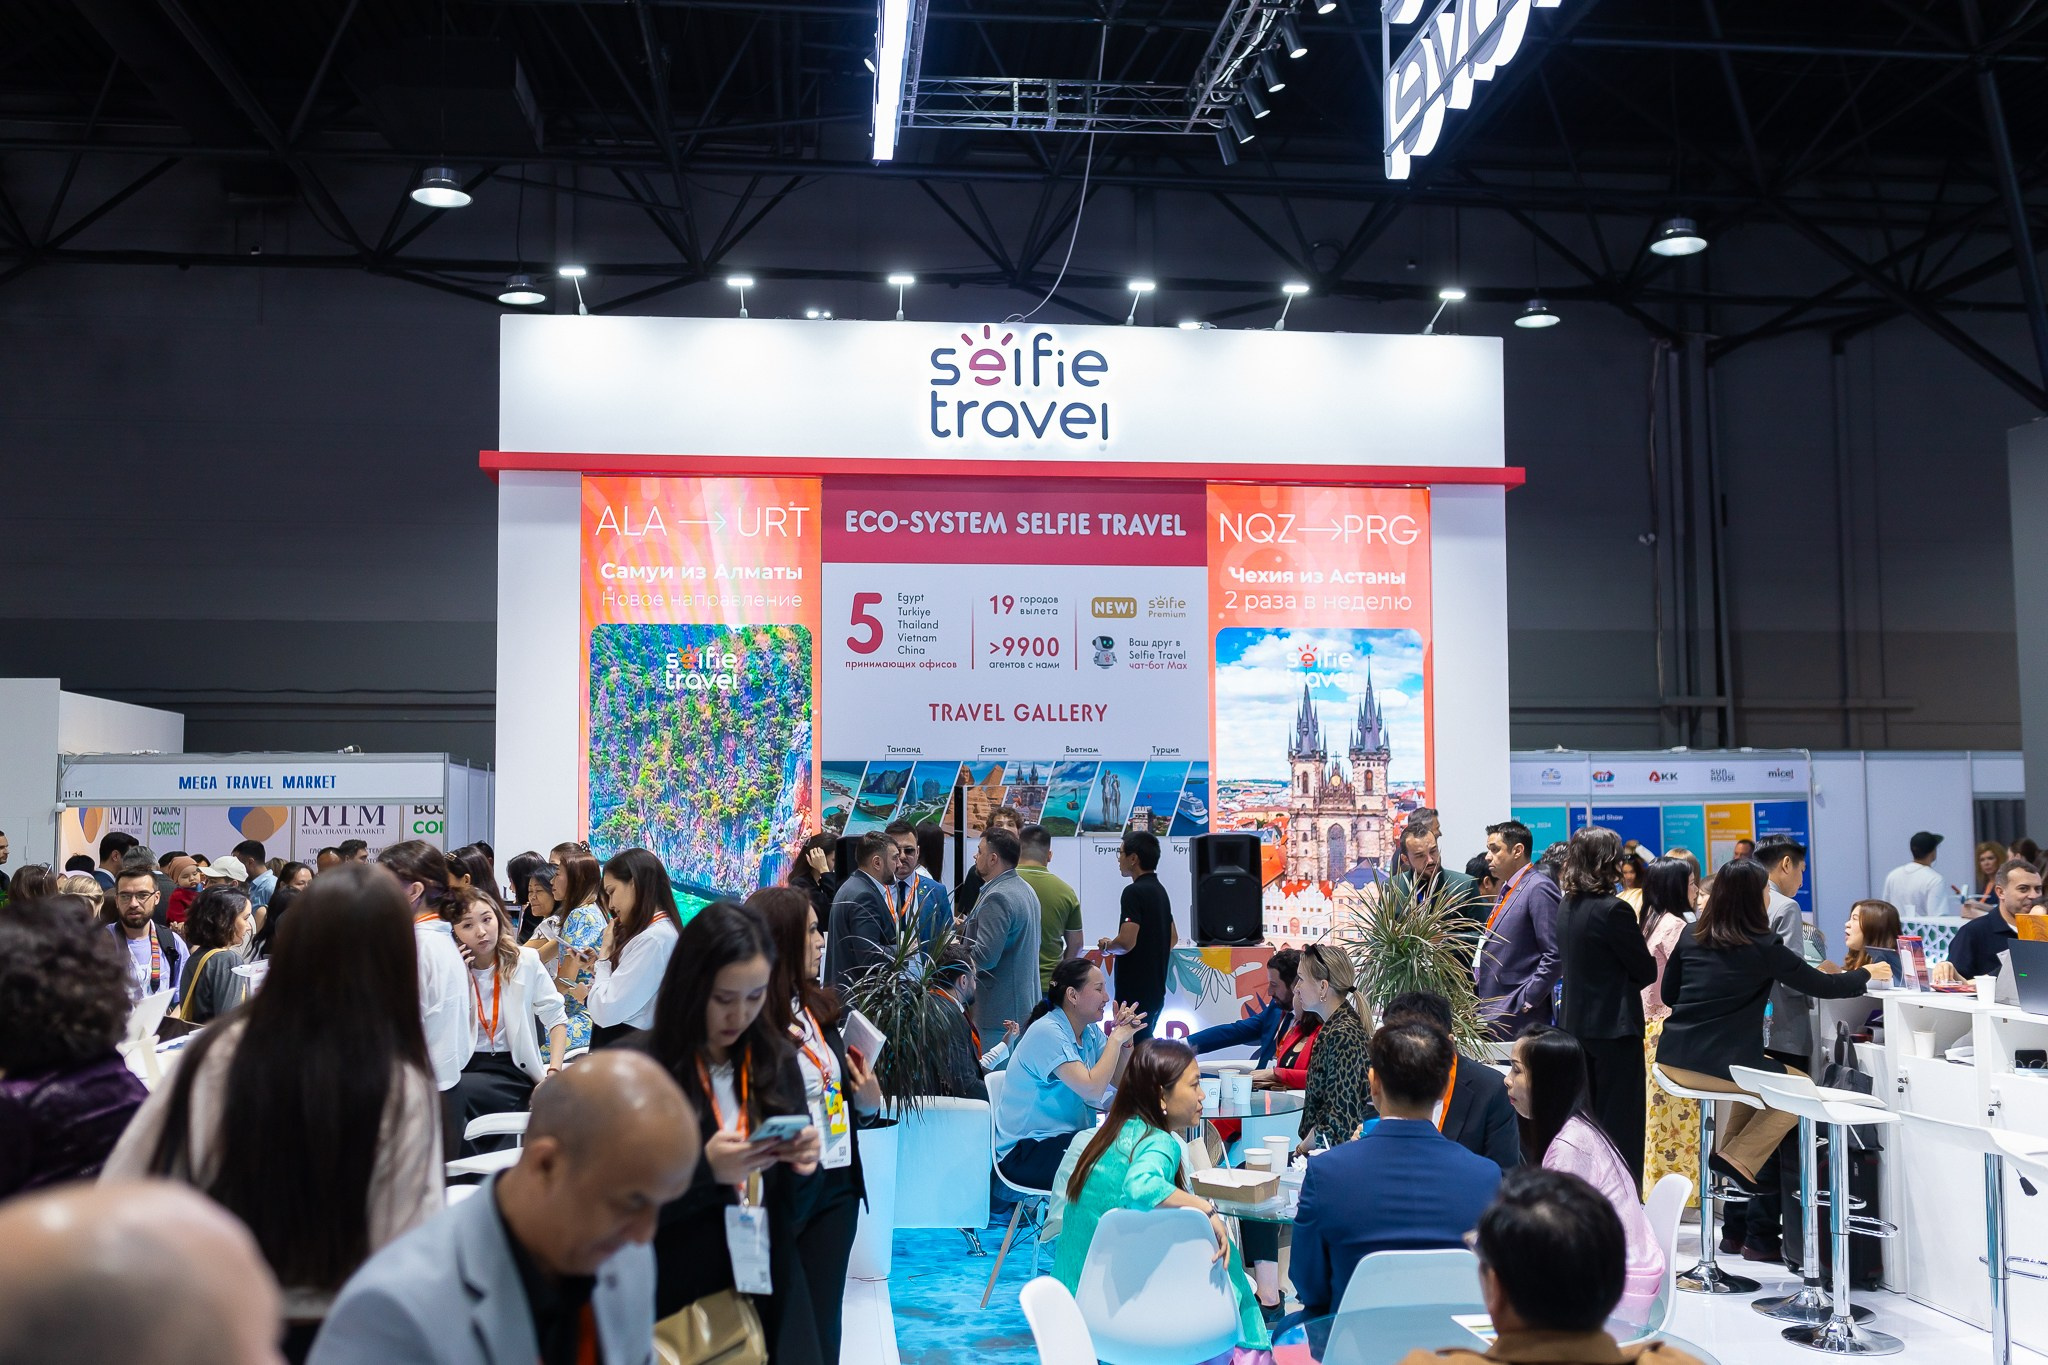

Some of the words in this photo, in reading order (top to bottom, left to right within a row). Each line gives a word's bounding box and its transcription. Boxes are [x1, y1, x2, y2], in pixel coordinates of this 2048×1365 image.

[930, 325, 1109, 387] selfie
[930, 390, 1109, 441] travel
[594, 505, 668, 537] ALA
[737, 505, 811, 538] URT
[845, 509, 1008, 535] ECO-SYSTEM
[1015, 511, 1091, 536] SELFIE
[1098, 513, 1187, 537] TRAVEL
[1219, 512, 1297, 544] NQZ
[1343, 514, 1419, 545] PRG
[600, 562, 674, 583] Самуи
[681, 563, 707, 580] из
[714, 564, 803, 581] Алматы
[1230, 568, 1294, 584] Чехия
[1300, 570, 1325, 584] из
[1330, 569, 1406, 585] Астаны
[602, 591, 664, 607] Новое
[671, 592, 803, 610] направление
[897, 592, 925, 604] Egypt
[989, 594, 1015, 615] 19
[1019, 596, 1059, 605] городов
[1148, 596, 1187, 609] selfie
[1224, 590, 1239, 609] 2
[1245, 594, 1297, 613] раза
[1304, 595, 1316, 609] в
[1324, 595, 1413, 611] неделю
[897, 607, 931, 619] Turkiye
[1019, 607, 1059, 615] вылета
[1093, 600, 1135, 615] NEW!
[1148, 610, 1187, 619] Premium
[846, 592, 884, 655] 5
[897, 619, 939, 630] Thailand
[897, 632, 937, 643] Vietnam
[1129, 637, 1150, 647] Ваш
[1151, 639, 1173, 650] друг
[897, 645, 926, 655] China
[989, 636, 1060, 657] >9900
[665, 644, 738, 669] selfie
[1129, 650, 1155, 660] Selfie
[1158, 650, 1187, 660] Travel
[1286, 644, 1354, 668] selfie
[845, 660, 916, 671] принимающих
[919, 658, 957, 671] офисов
[988, 661, 1026, 669] агентов
[1129, 661, 1165, 670] чат-бот
[665, 669, 738, 691] travel
[929, 703, 1005, 722] TRAVEL
[1013, 703, 1108, 722] GALLERY
[980, 744, 1007, 753] Египет
[1065, 745, 1099, 753] Вьетнам
[1152, 745, 1180, 756] Турция
[178, 775, 218, 790] MEGA
[226, 775, 273, 789] TRAVEL
[282, 775, 337, 789] MARKET
[64, 790, 83, 798] 11-14
[152, 821, 181, 836] CORRECT
[301, 828, 323, 836] MEGA
[325, 828, 352, 836] TRAVEL
[354, 828, 386, 836] MARKET
